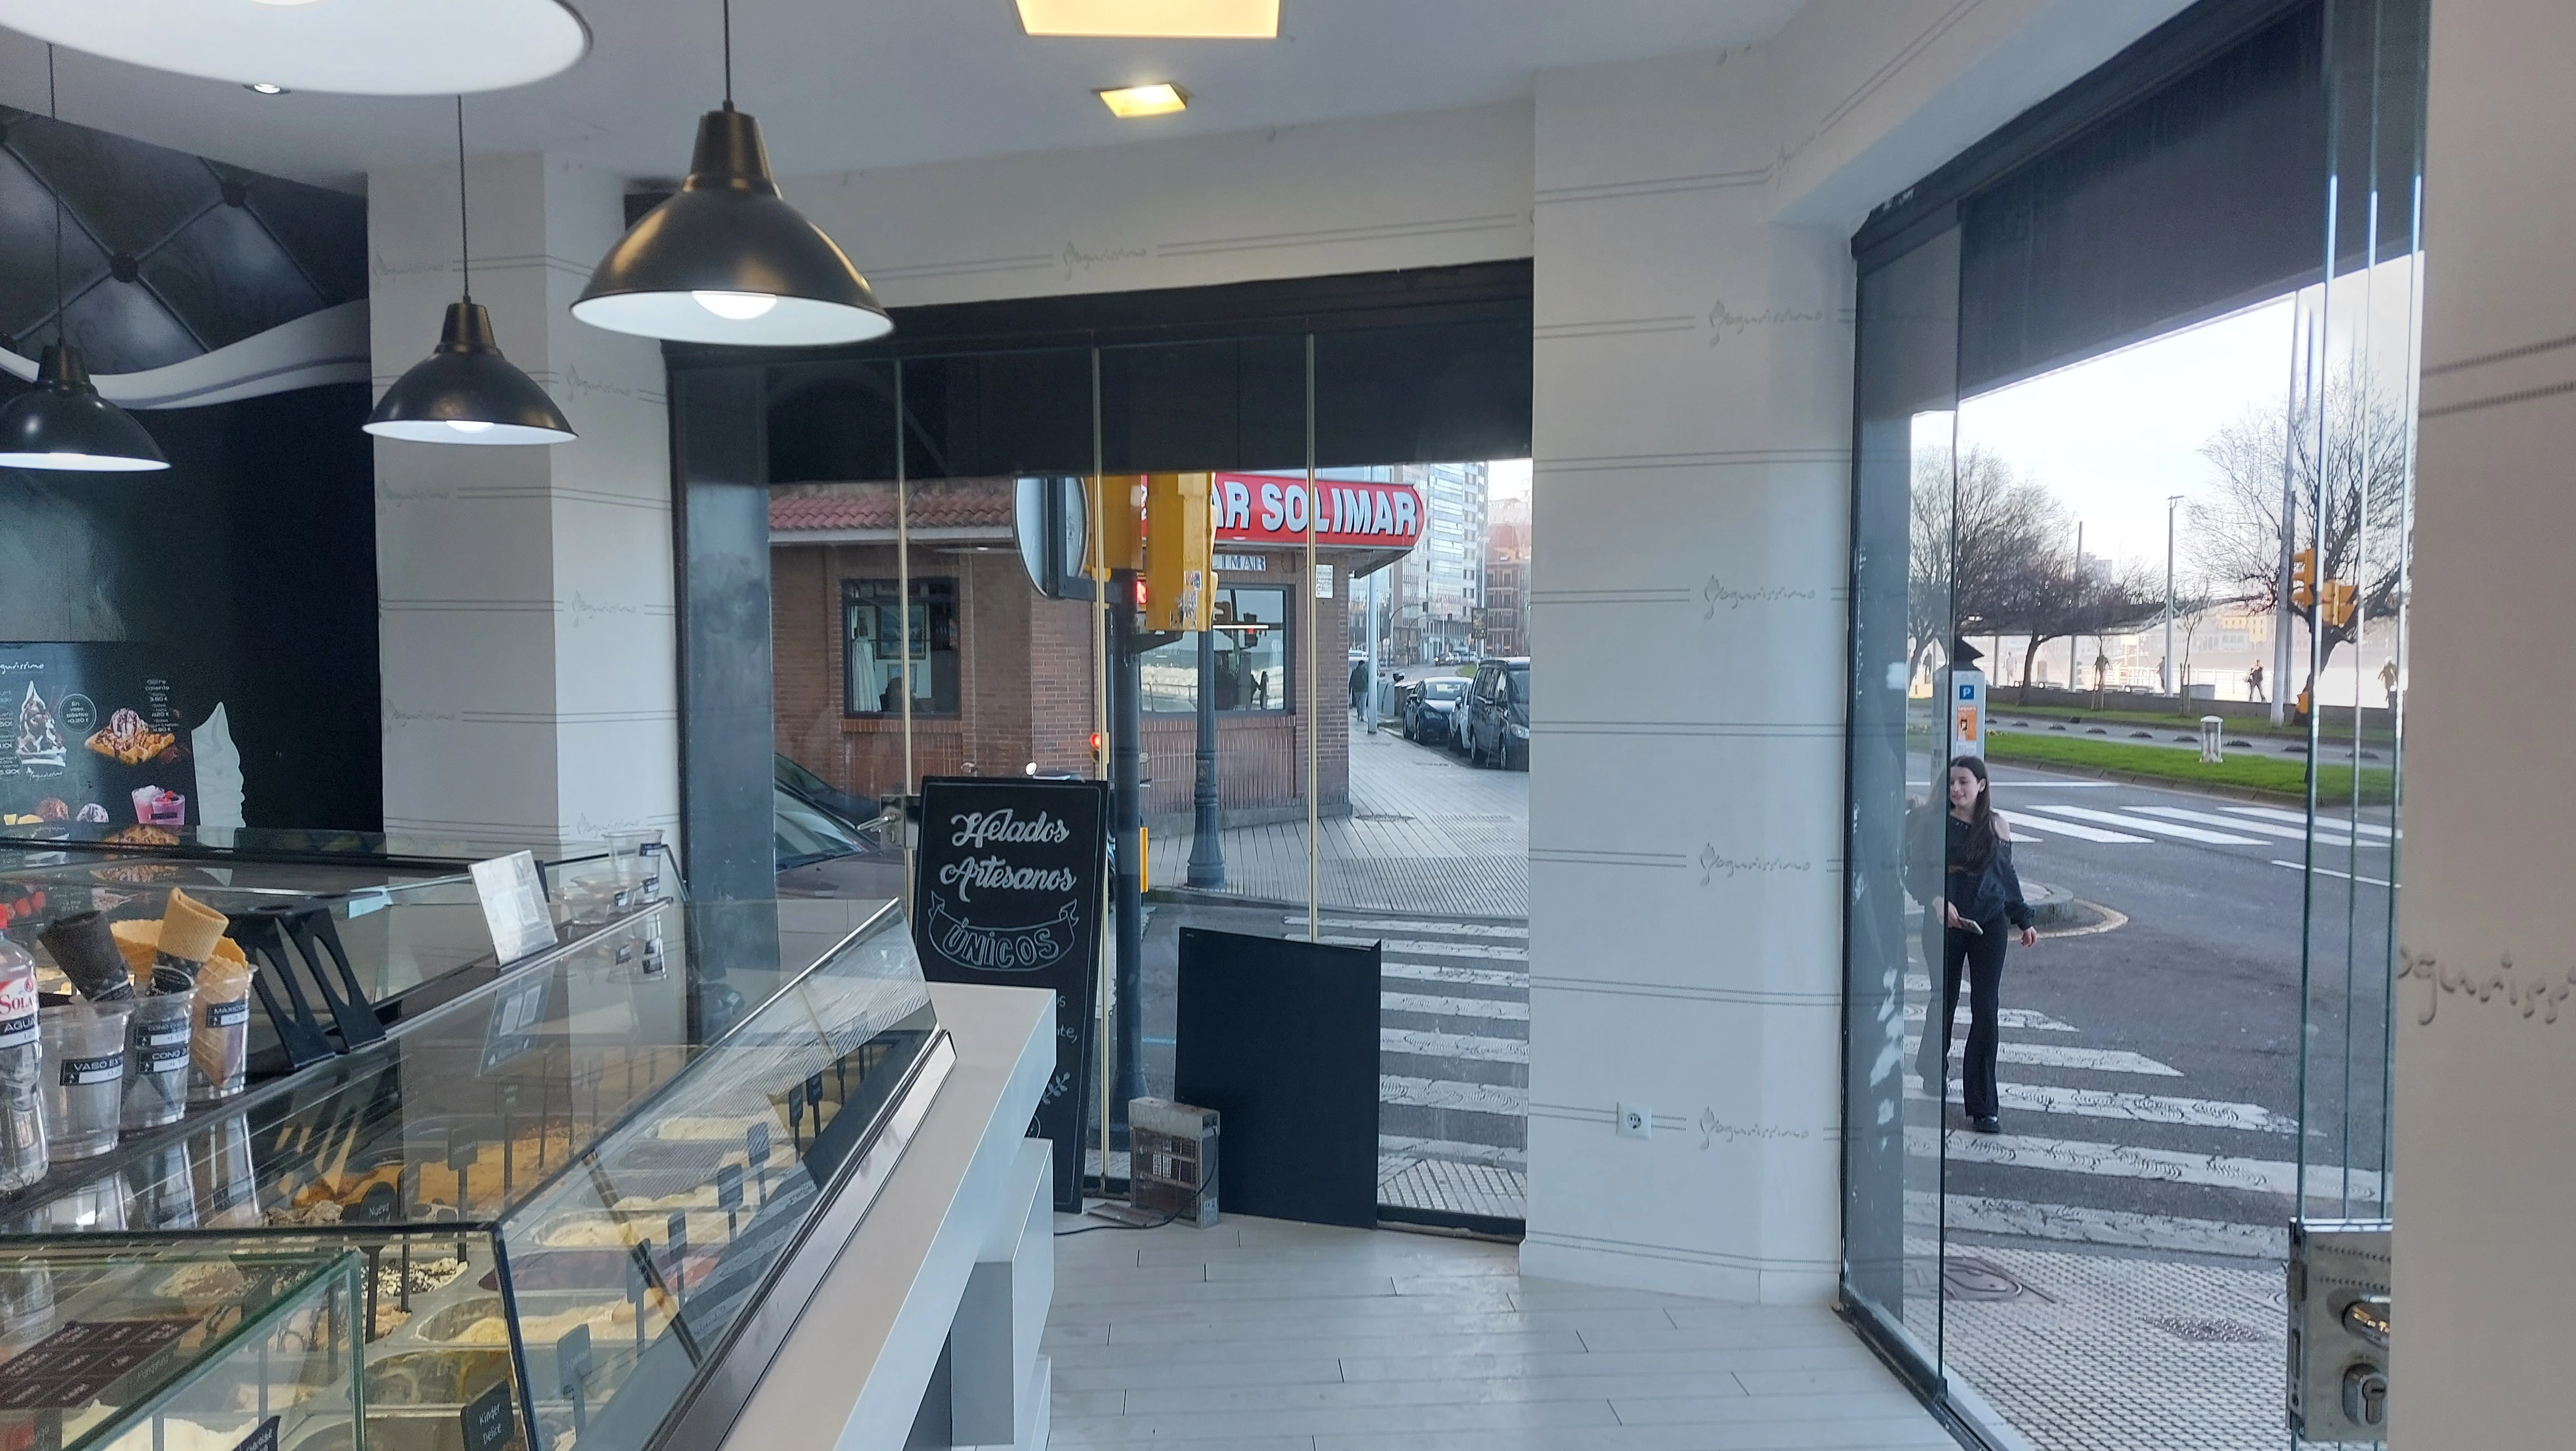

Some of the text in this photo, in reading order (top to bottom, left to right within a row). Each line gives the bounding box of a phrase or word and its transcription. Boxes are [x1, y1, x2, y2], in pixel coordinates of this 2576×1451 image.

[1212, 480, 1417, 536] AR SOLIMAR
[1963, 687, 1971, 697] P
[950, 808, 1070, 849] Helados
[939, 855, 1077, 903] Artesanos
[4, 1017, 36, 1033] AGUA
[152, 1049, 179, 1060] CONO
[74, 1060, 107, 1071] VASO
[368, 1202, 389, 1218] Nueva
[479, 1402, 500, 1426] Kinder
[483, 1423, 502, 1445] Delice
